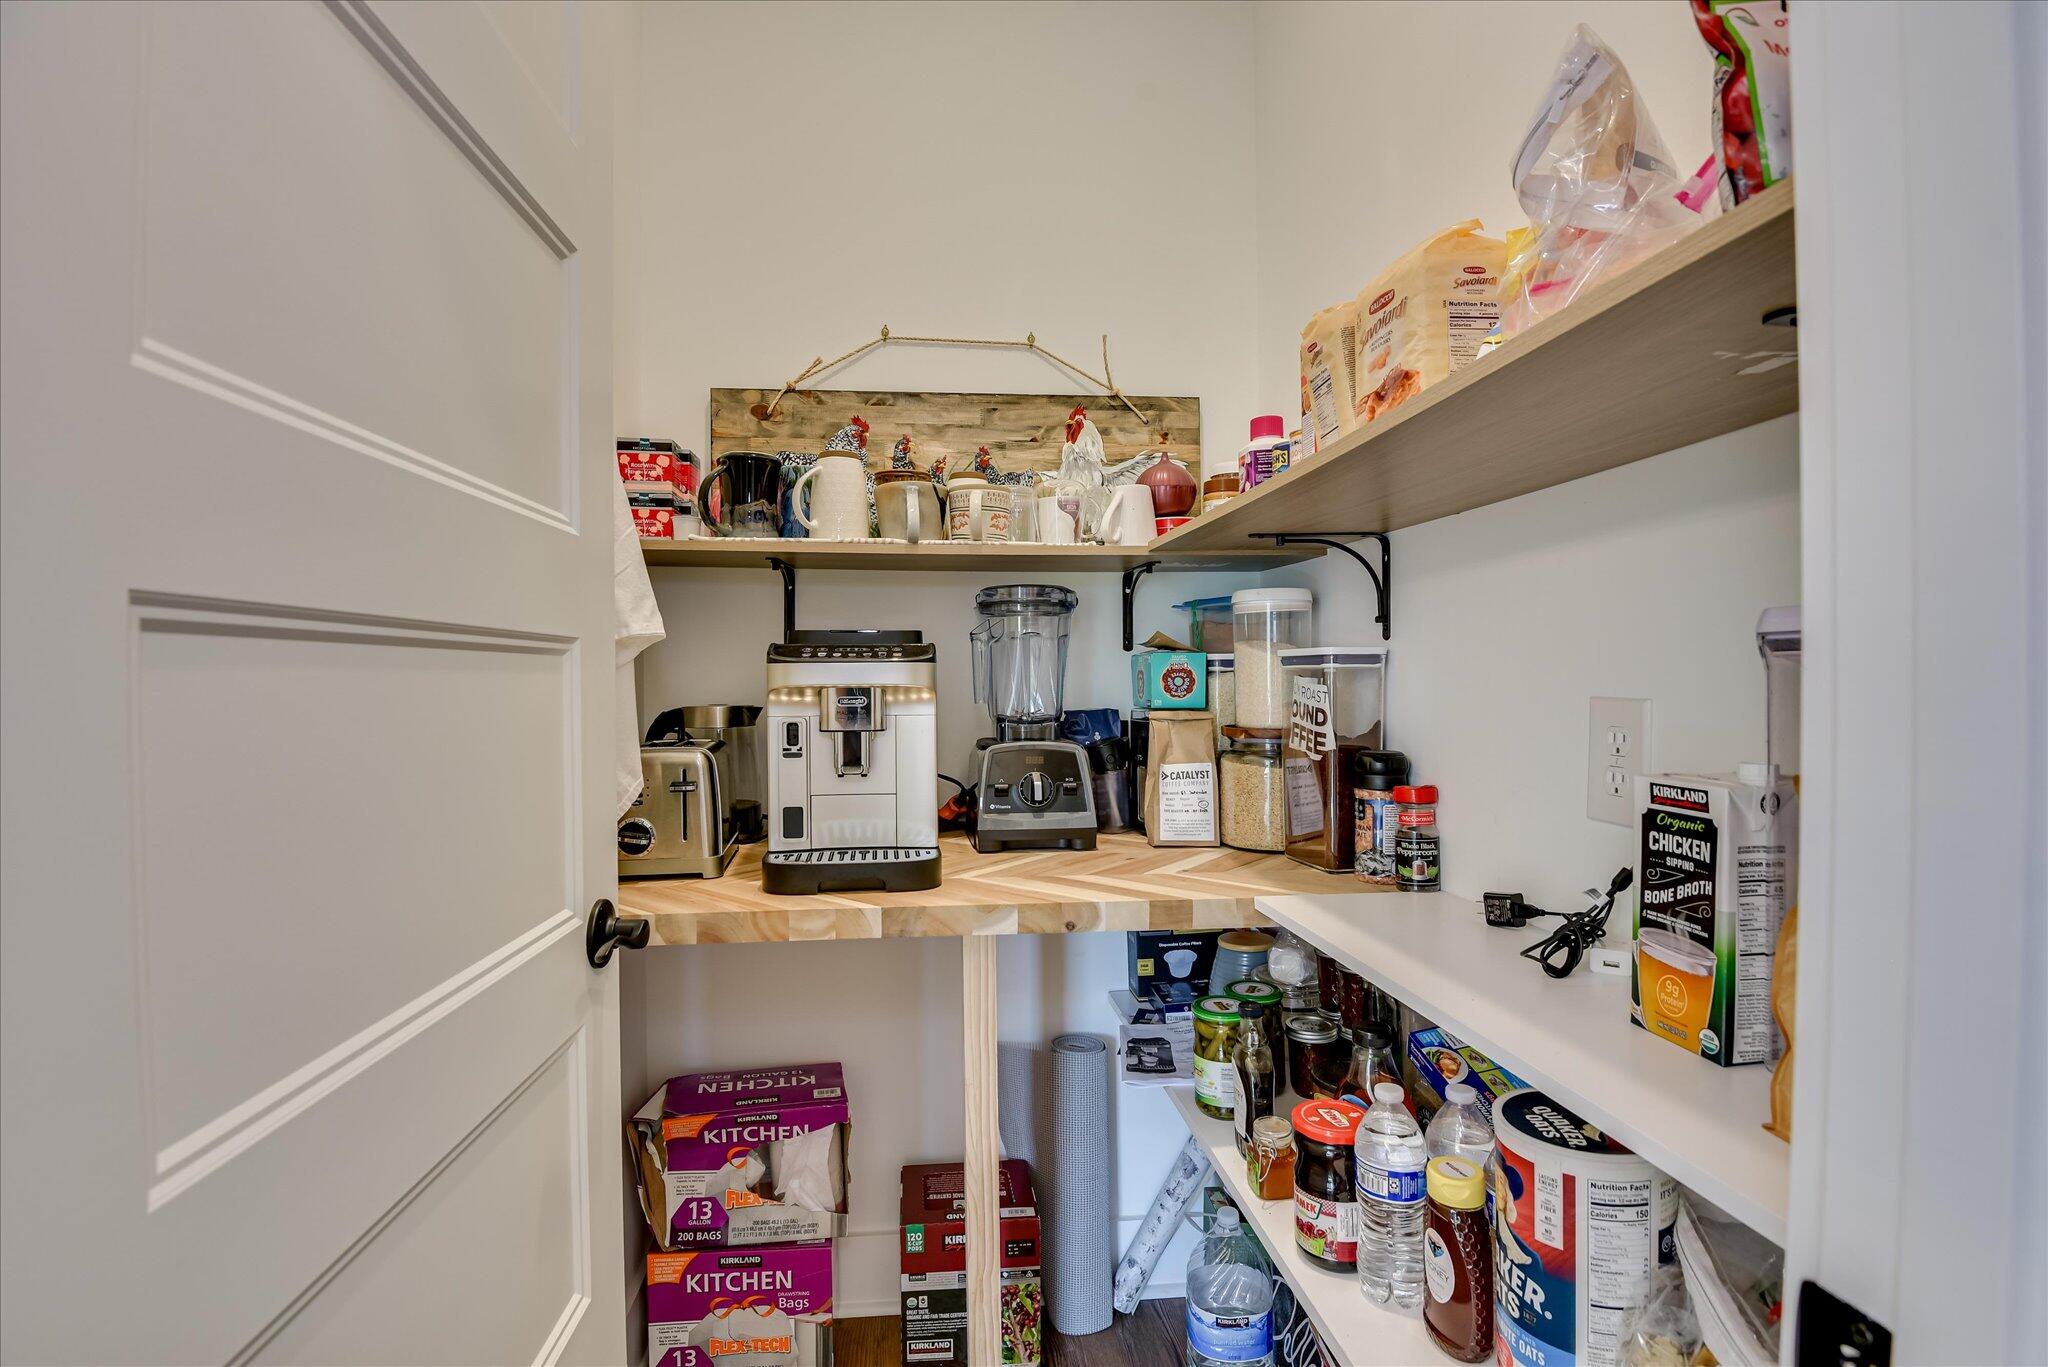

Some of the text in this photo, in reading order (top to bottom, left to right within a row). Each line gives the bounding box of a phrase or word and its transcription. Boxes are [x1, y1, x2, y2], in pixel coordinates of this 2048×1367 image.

[1453, 276, 1498, 289] Savoiardi
[1301, 685, 1328, 704] ROAST
[1170, 770, 1210, 780] CATALYST
[1652, 785, 1707, 804] KIRKLAND
[1656, 812, 1705, 832] Organic
[1401, 842, 1420, 850] Whole
[1648, 830, 1711, 863] CHICKEN
[1666, 856, 1695, 872] SIPPING
[1644, 881, 1712, 904] BONE BROTH
[1665, 980, 1680, 997] 9g
[743, 1071, 788, 1079] GALLON
[697, 1075, 816, 1094] KITCHEN
[735, 1097, 778, 1105] KIRKLAND
[737, 1114, 778, 1123] KIRKLAND
[1525, 1114, 1560, 1138] OATS
[1531, 1106, 1588, 1147] QUAKER
[704, 1124, 810, 1144] KITCHEN
[1590, 1182, 1628, 1191] Nutrition
[688, 1200, 713, 1220] 13
[1295, 1194, 1317, 1214] AMEK
[1590, 1209, 1649, 1219] Calories 150
[677, 1231, 722, 1241] 200 BAGS
[907, 1232, 922, 1241] 120
[720, 1256, 761, 1265] KIRKLAND
[687, 1270, 792, 1293] KITCHEN
[778, 1297, 810, 1310] Bags
[709, 1336, 791, 1356] FLEX-TECH
[911, 1341, 950, 1350] KIRKLAND
[1519, 1341, 1545, 1366] OATS
[673, 1349, 696, 1367] 13
